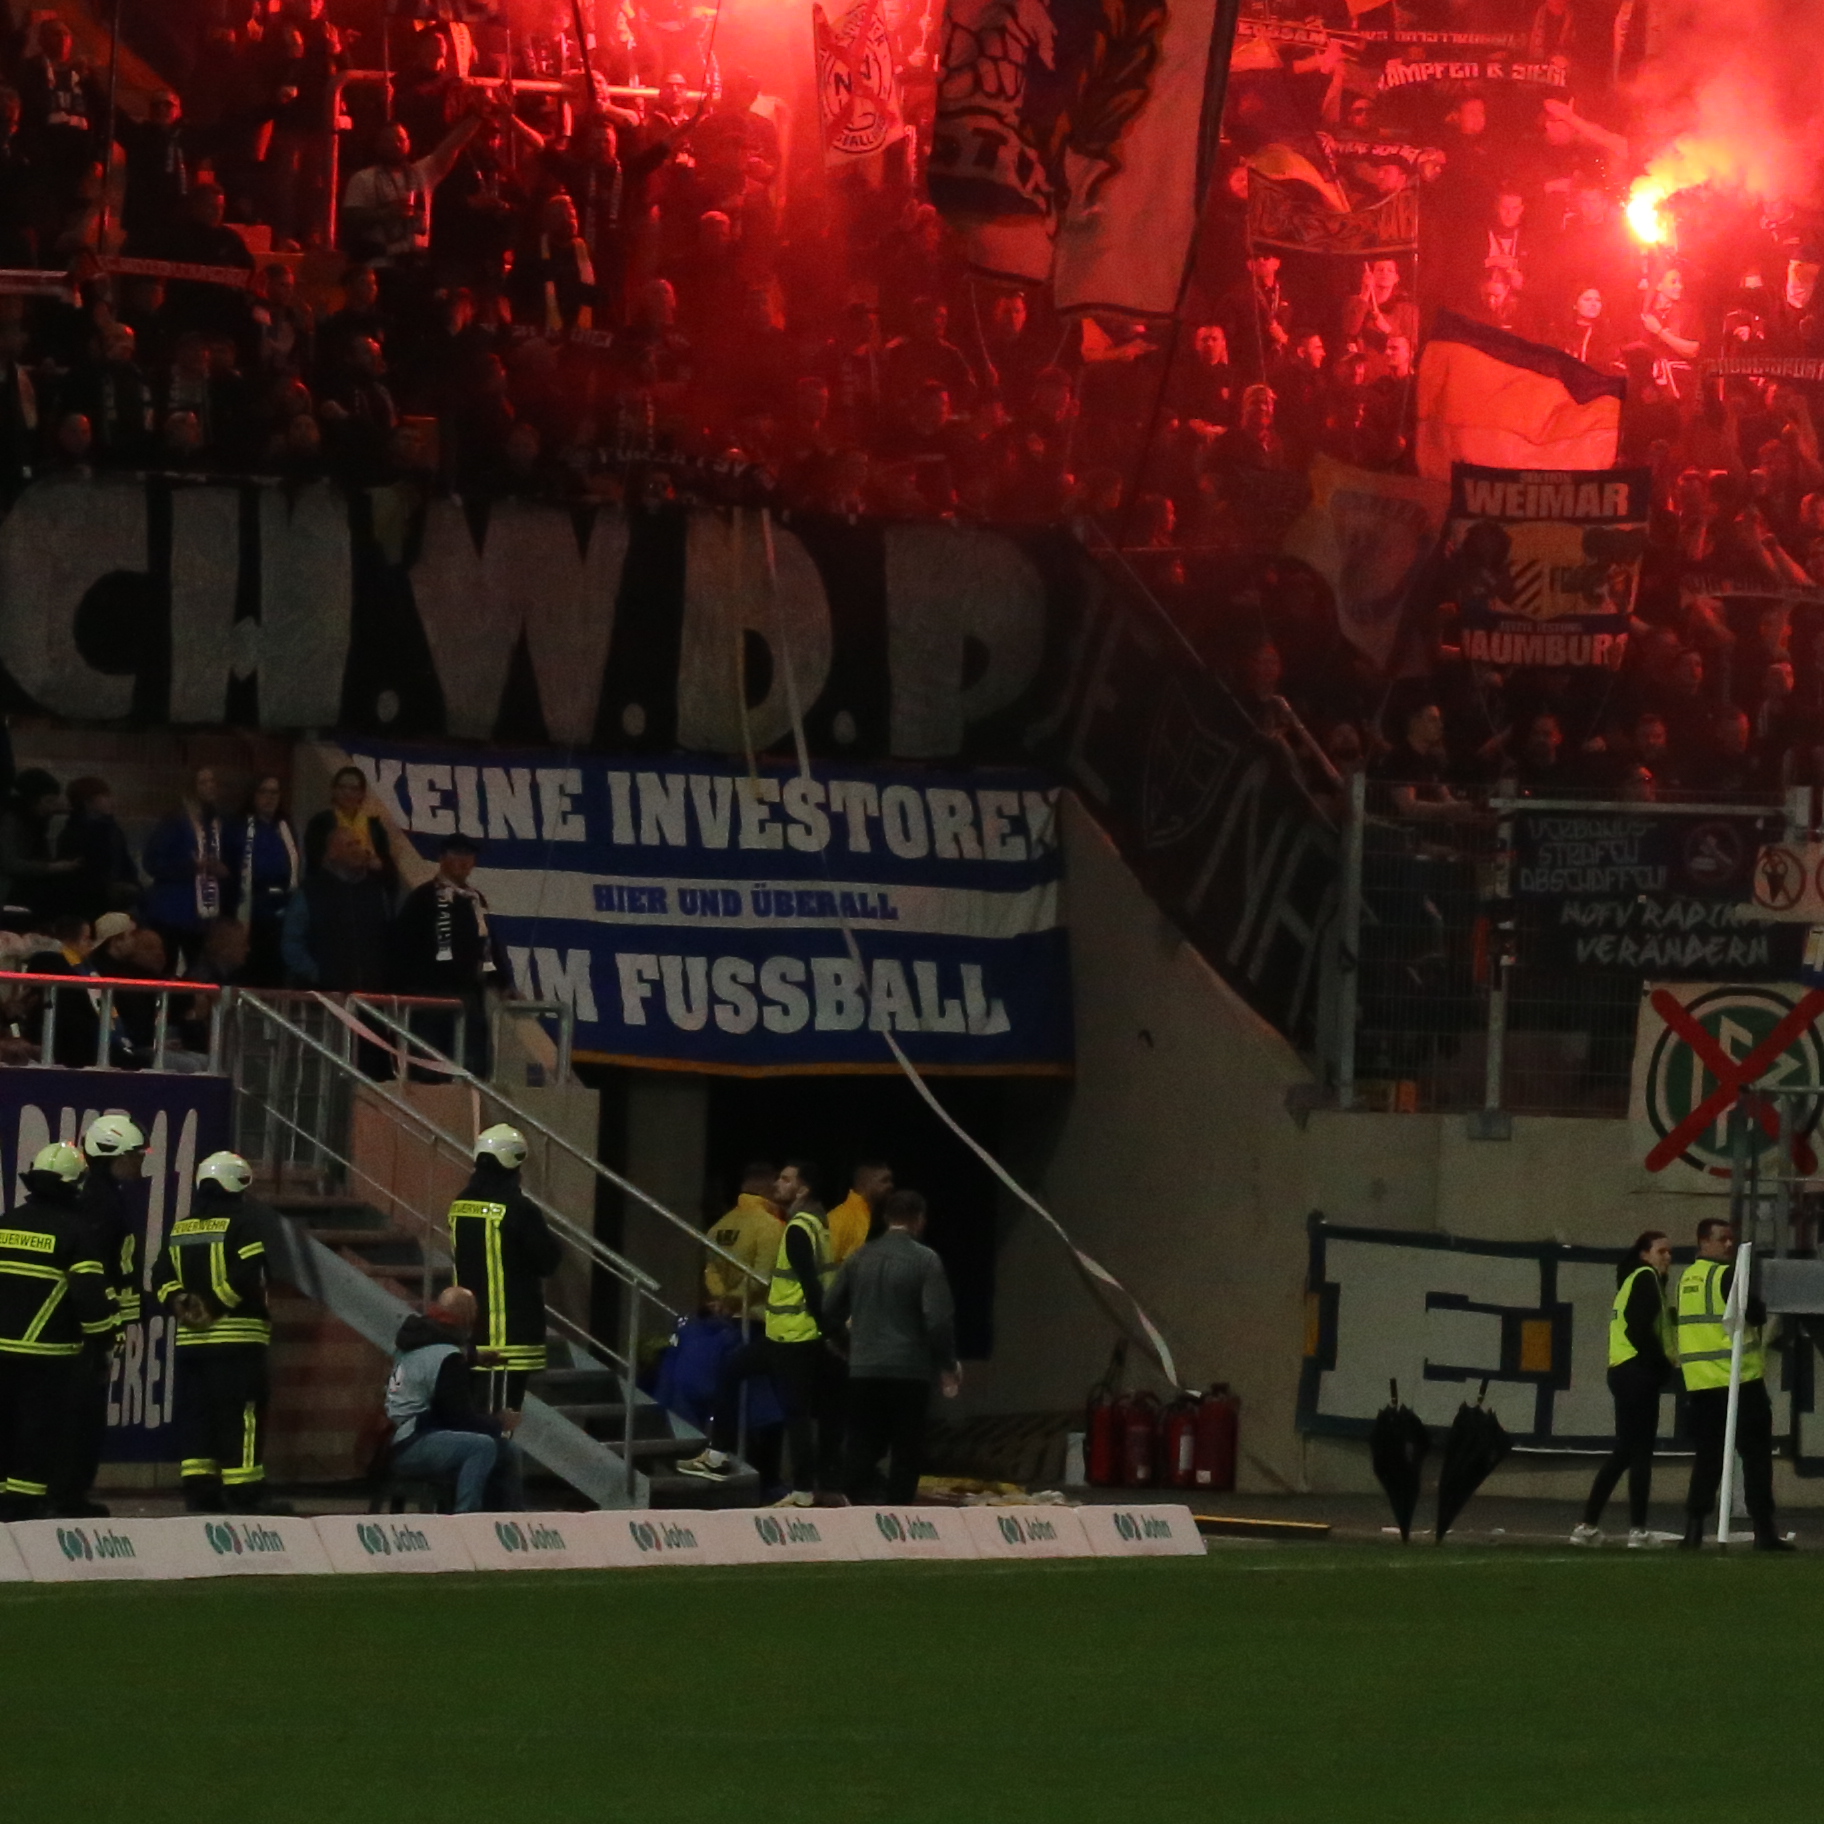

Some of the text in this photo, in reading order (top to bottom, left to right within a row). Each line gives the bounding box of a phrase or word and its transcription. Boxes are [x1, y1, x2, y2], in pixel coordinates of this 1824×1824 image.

[1464, 478, 1630, 517] WEIMAR
[349, 752, 1061, 863] KEINE INVESTOREN
[592, 880, 898, 920] HIER UND ÜBERALL
[1574, 928, 1771, 967] VERÄNDERN
[614, 951, 1012, 1037] FUSSBALL
[244, 1522, 285, 1553] John
[392, 1523, 430, 1552] John
[527, 1523, 566, 1550] John
[663, 1521, 698, 1550] John
[786, 1515, 821, 1543] John
[906, 1515, 941, 1542] John
[1026, 1513, 1058, 1541] John
[95, 1530, 136, 1559] John
